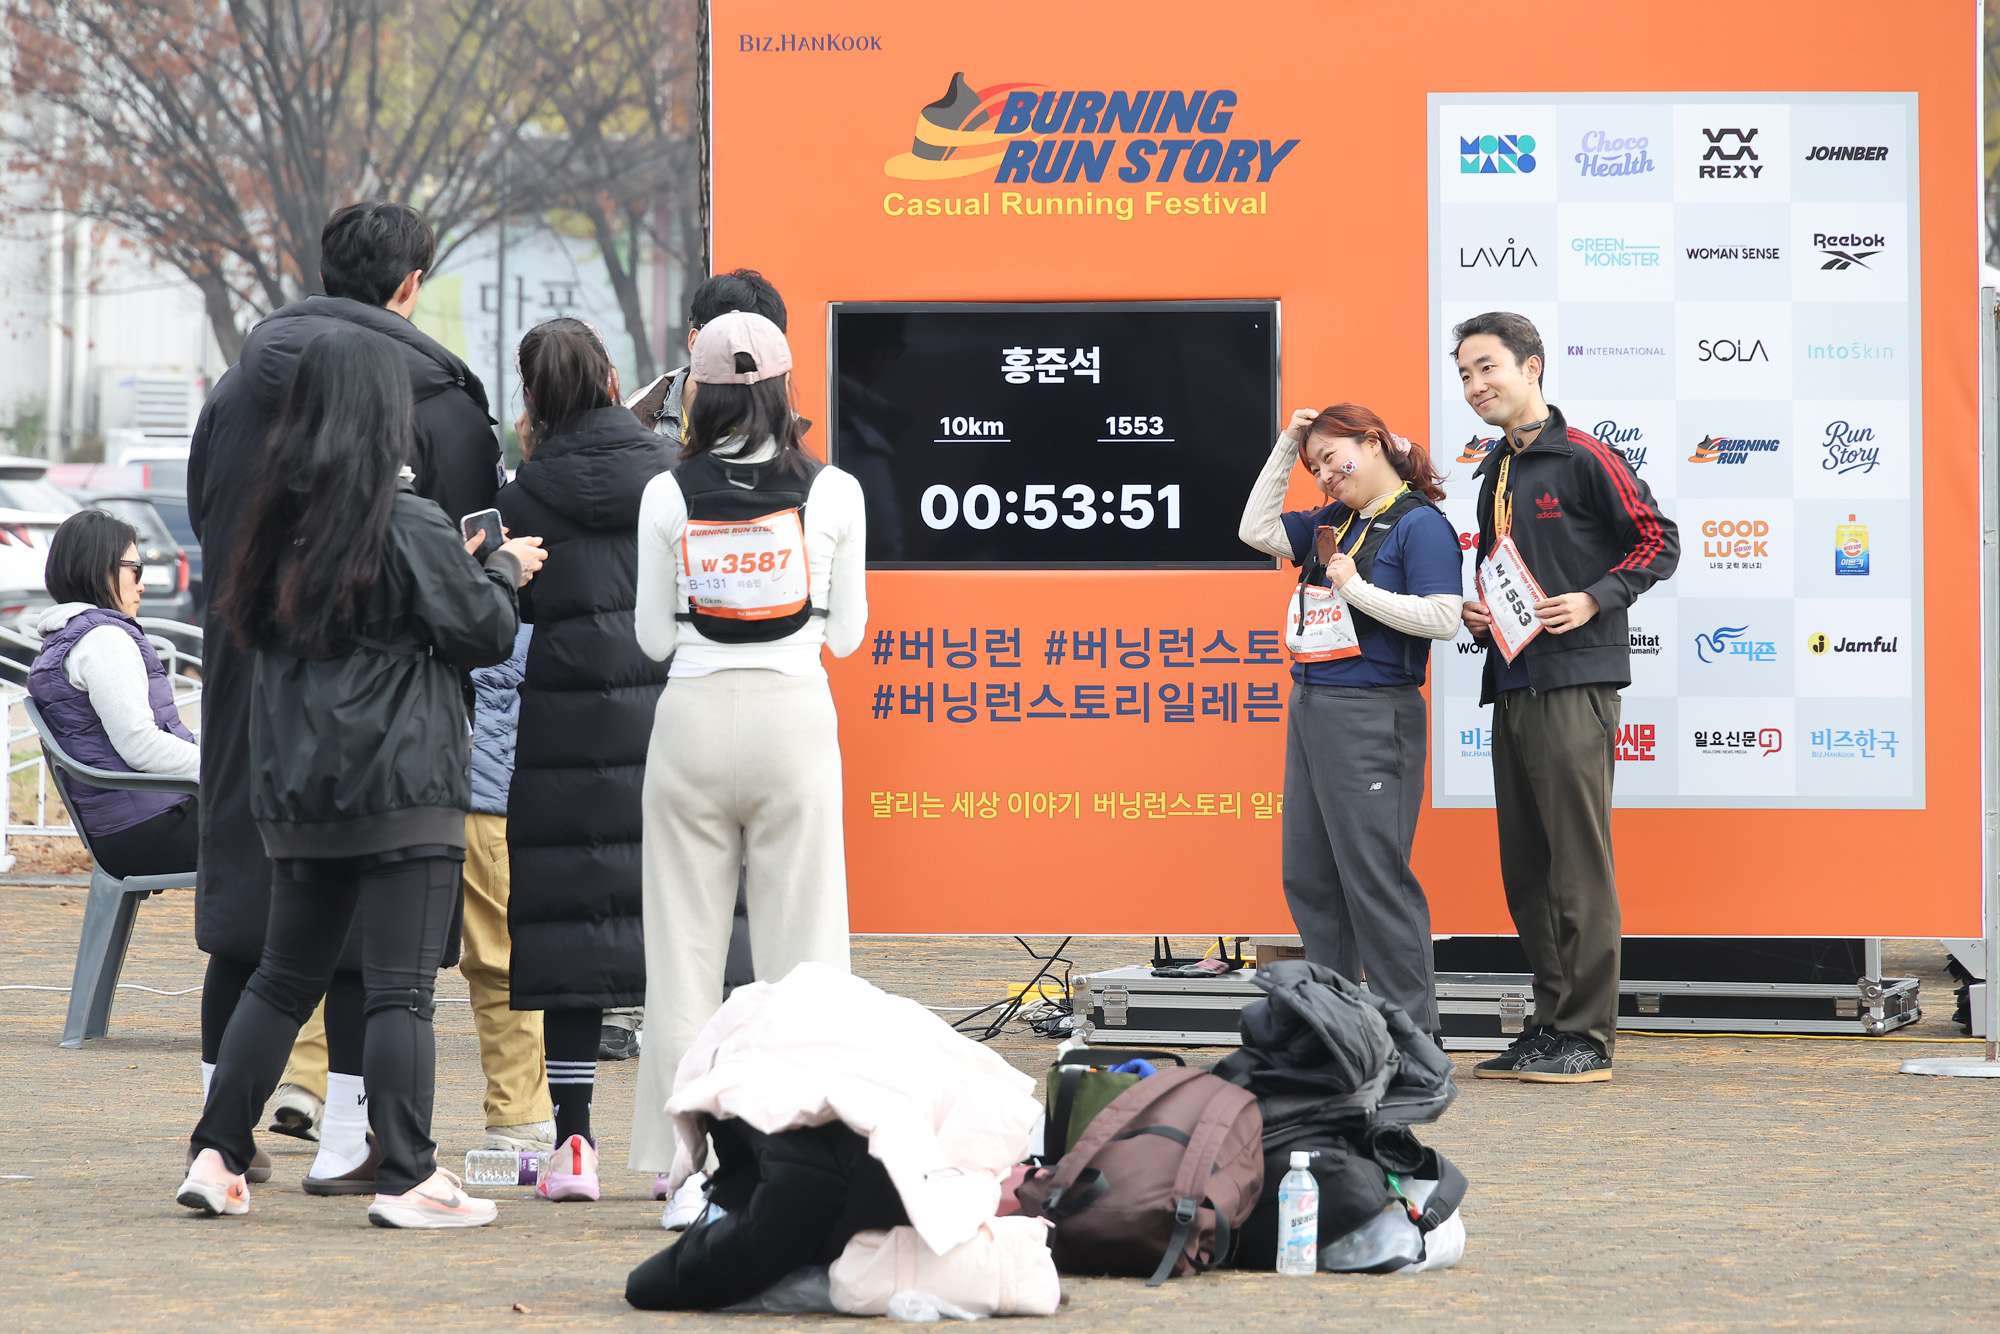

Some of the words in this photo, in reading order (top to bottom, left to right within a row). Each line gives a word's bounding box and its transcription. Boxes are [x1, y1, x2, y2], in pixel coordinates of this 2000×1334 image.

[994, 90, 1238, 134] BURNING
[1461, 135, 1536, 154] MONO
[1581, 130, 1649, 153] Choco
[994, 140, 1116, 183] RUN
[1117, 140, 1301, 183] STORY
[1806, 147, 1888, 160] JOHNBER
[1461, 154, 1536, 173] MANO
[1575, 150, 1655, 177] Health
[1700, 166, 1763, 178] REXY
[883, 193, 990, 216] Casual
[1001, 190, 1133, 221] Running
[1145, 192, 1267, 215] Festival
[1571, 238, 1625, 252] GREEN
[1814, 234, 1884, 248] Reebok
[1584, 252, 1660, 267] MONSTER
[1686, 247, 1739, 260] WOMAN
[1741, 247, 1780, 260] SENSE
[1567, 346, 1583, 356] KN
[1586, 347, 1666, 356] INTERNATIONAL
[1001, 346, 1100, 384] 홍준석
[939, 416, 1004, 436] 10km
[1105, 416, 1164, 436] 1553
[1593, 420, 1643, 447] Run
[1822, 420, 1876, 447] Run
[1717, 439, 1780, 452] BURNING
[1717, 452, 1749, 465] RUN
[1822, 444, 1880, 475] Story
[920, 484, 1181, 530] 00:53:51
[1536, 512, 1562, 520] adidas
[690, 528, 729, 537] BURNING
[1702, 521, 1768, 537] GOOD
[1503, 544, 1522, 571] BURNING
[1704, 540, 1769, 558] LUCK
[721, 548, 793, 575] 3587
[689, 577, 727, 591] B-131
[1495, 563, 1505, 578] M
[1500, 577, 1532, 627] 1553
[872, 627, 1021, 669] #버닝런
[1044, 628, 1297, 668] #버닝런스토
[1630, 633, 1660, 646] bitat
[1834, 636, 1898, 653] Jamful
[1729, 641, 1777, 662] 피죤
[872, 682, 1283, 723] #버닝런스토리일레븐
[1694, 731, 1757, 747] 일요신문
[1811, 728, 1899, 758] 비즈한국
[870, 790, 945, 820] 달리는
[950, 790, 1001, 820] 세상
[1007, 790, 1081, 820] 이야기
[1093, 790, 1242, 820] 버닝런스토리
[529, 1159, 537, 1172] KN
